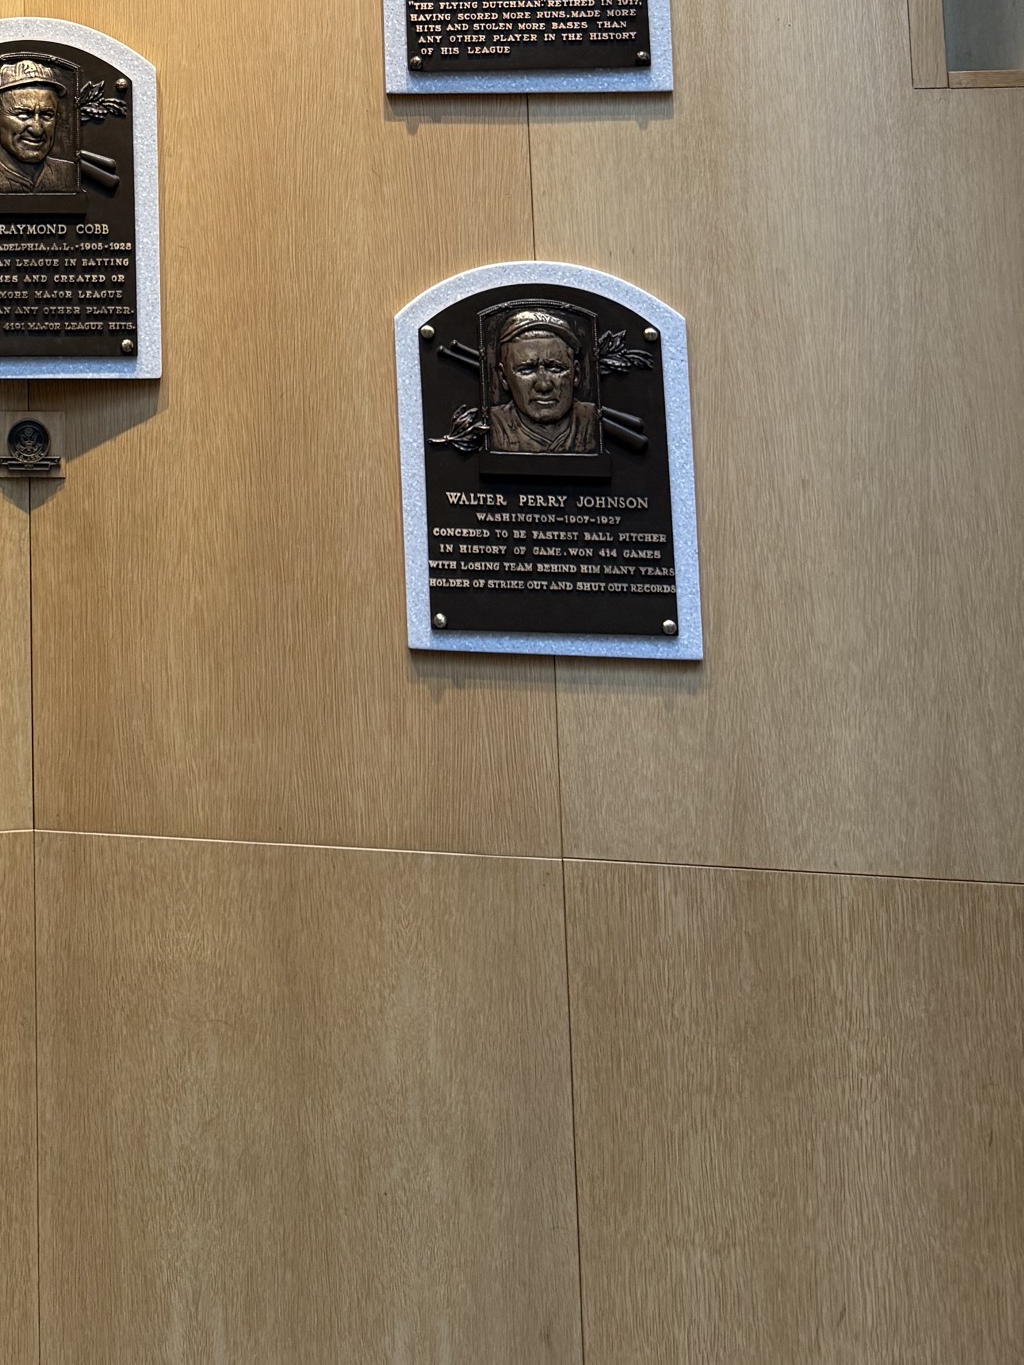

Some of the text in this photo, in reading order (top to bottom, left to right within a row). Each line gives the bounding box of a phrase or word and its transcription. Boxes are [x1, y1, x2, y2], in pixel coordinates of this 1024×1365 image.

[590, 32, 636, 40] HISTORY
[0, 224, 67, 234] RAYMOND
[76, 224, 109, 234] COBB
[82, 258, 129, 266] BATTING
[446, 492, 648, 508] WALTER PERRY JOHNSON
[433, 528, 490, 537] CONCEDED
[513, 530, 526, 538] BE
[532, 531, 578, 540] FASTEST
[584, 532, 613, 541] BALL
[619, 533, 666, 542] PITCHER
[440, 544, 453, 552] IN
[459, 545, 506, 554] HISTORY
[568, 548, 593, 556] WON
[599, 549, 617, 557] 414
[623, 550, 661, 558] GAMES
[428, 560, 675, 576] WITH LOSING TEAM BEHIND HIM MANY YEARS
